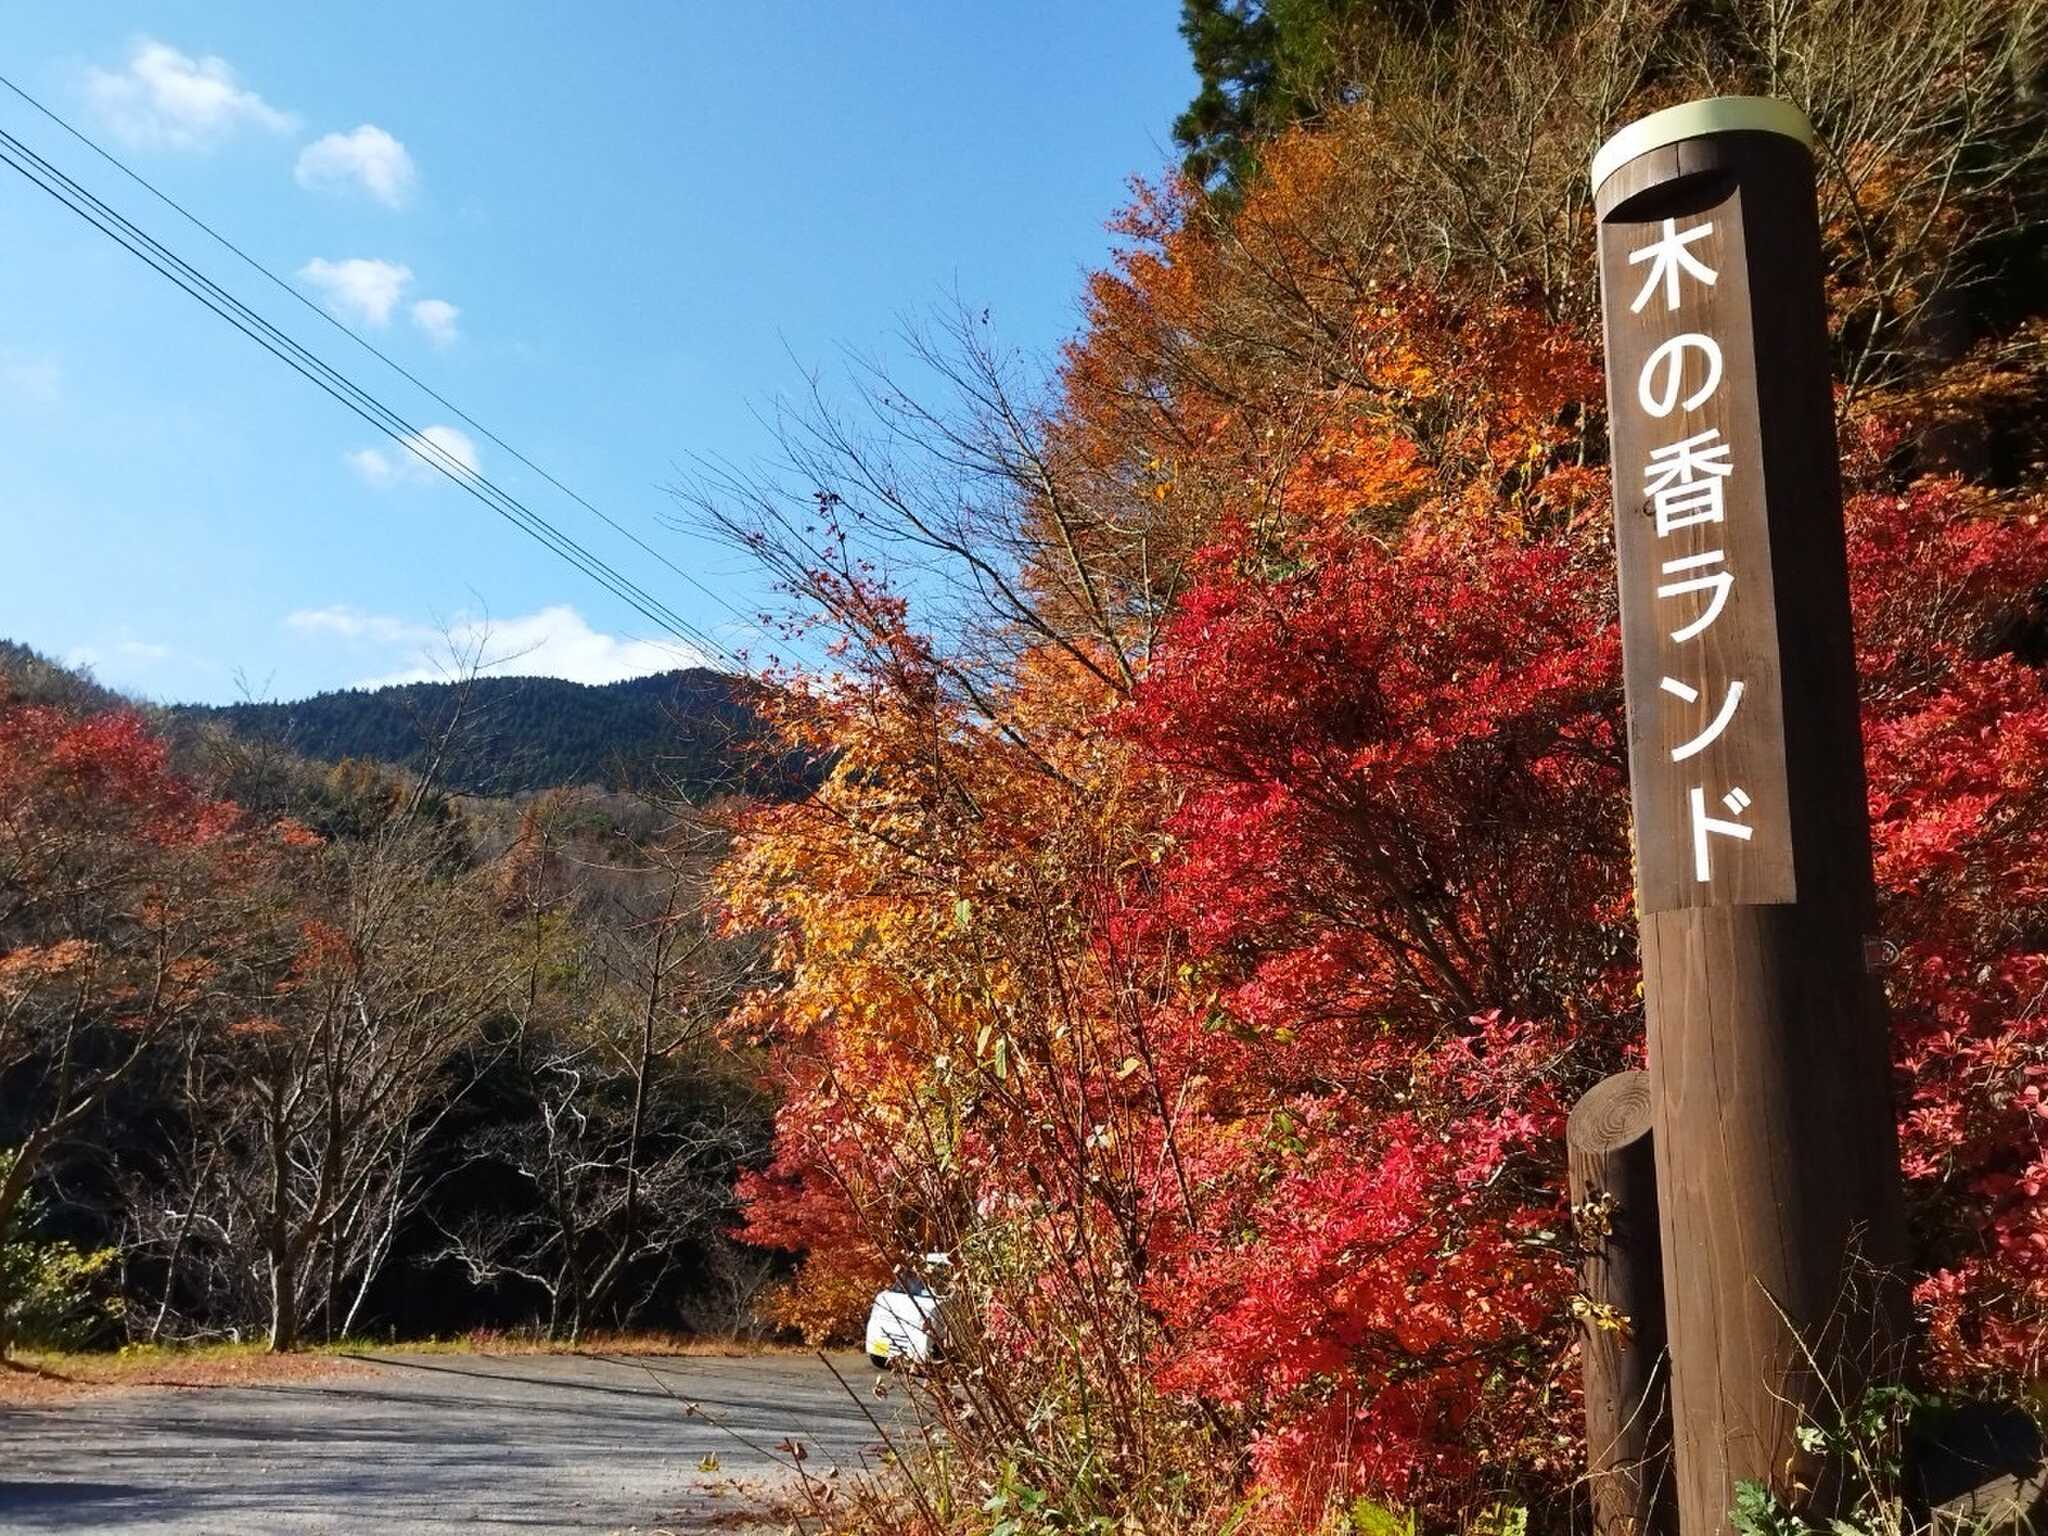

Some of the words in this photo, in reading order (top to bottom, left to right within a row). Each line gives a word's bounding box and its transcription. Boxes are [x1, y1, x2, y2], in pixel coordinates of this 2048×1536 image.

[1628, 217, 1753, 882] 木の香ランド
